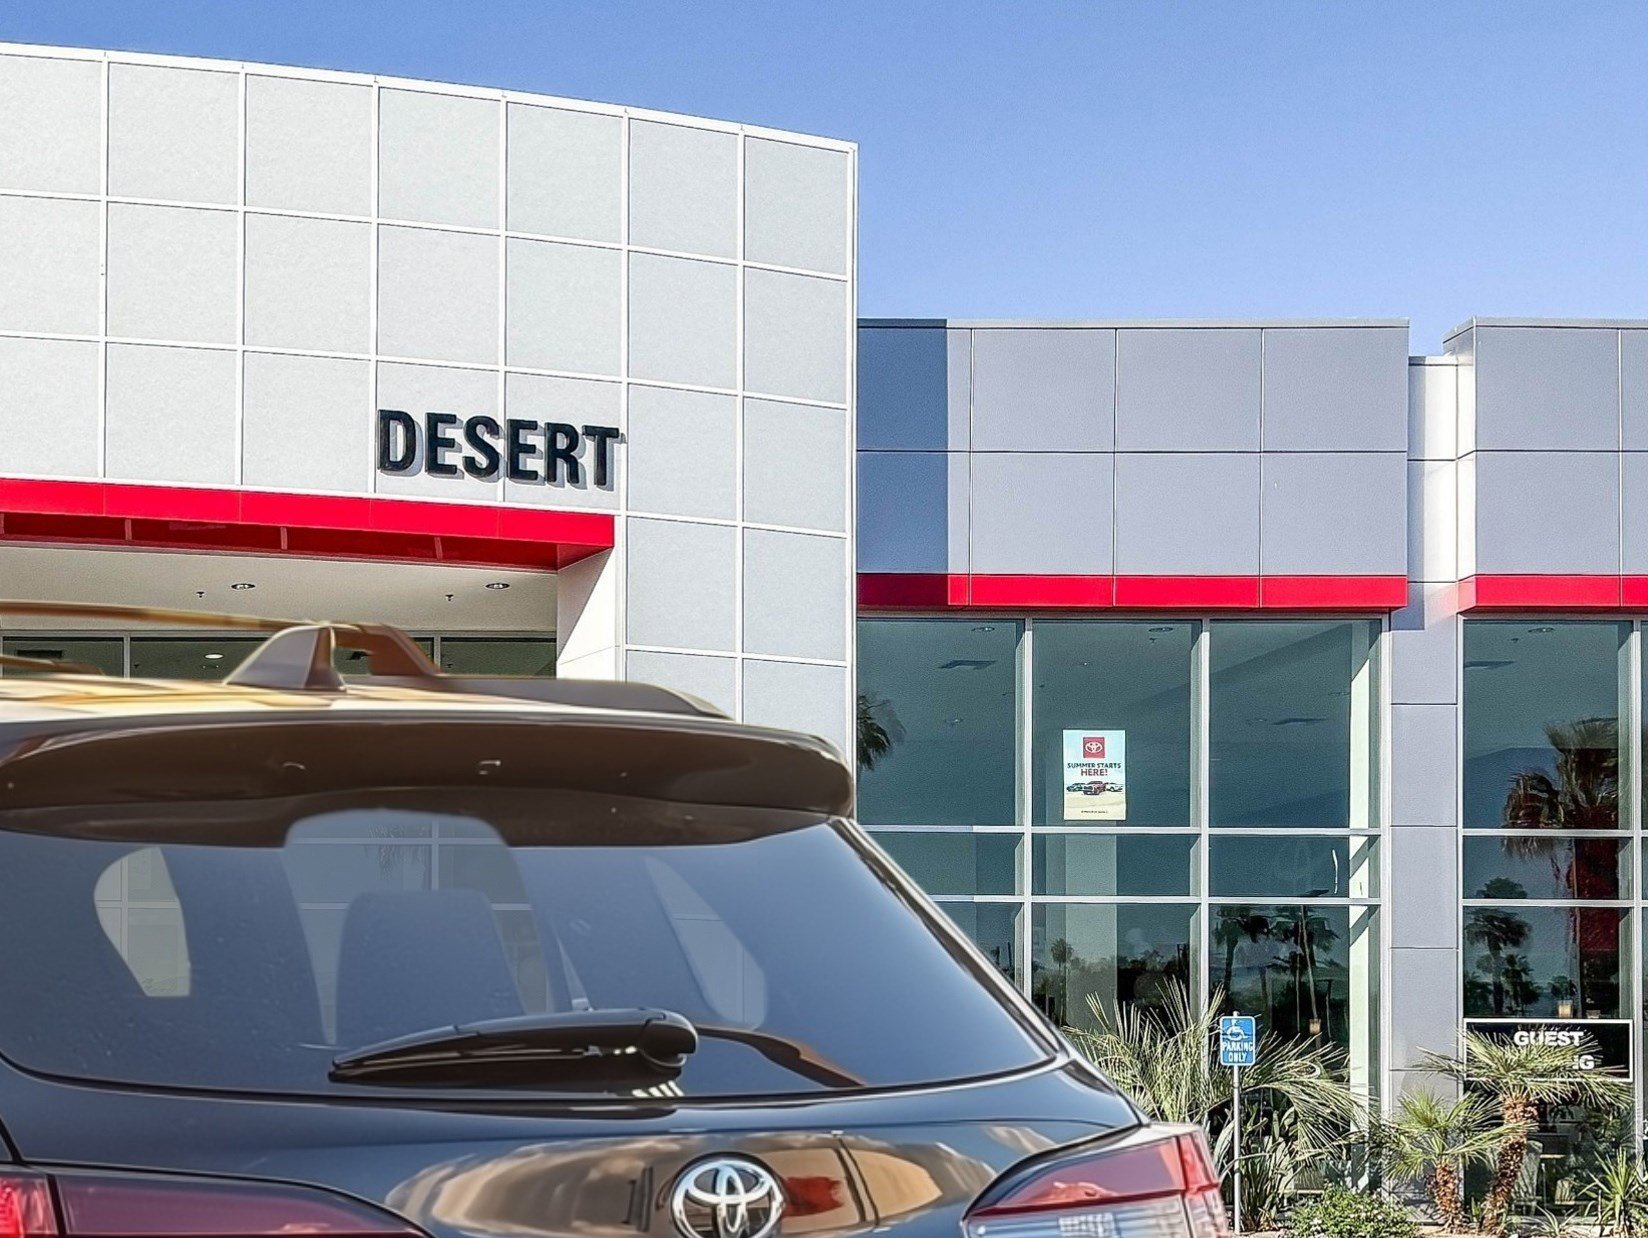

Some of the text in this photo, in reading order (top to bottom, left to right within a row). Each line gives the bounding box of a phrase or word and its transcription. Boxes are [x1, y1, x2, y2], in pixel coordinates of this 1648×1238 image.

[377, 409, 621, 487] DESERT
[1080, 768, 1108, 776] HERE!
[1513, 1031, 1584, 1046] GUEST
[1222, 1041, 1253, 1051] PARKING
[1228, 1052, 1247, 1062] ONLY
